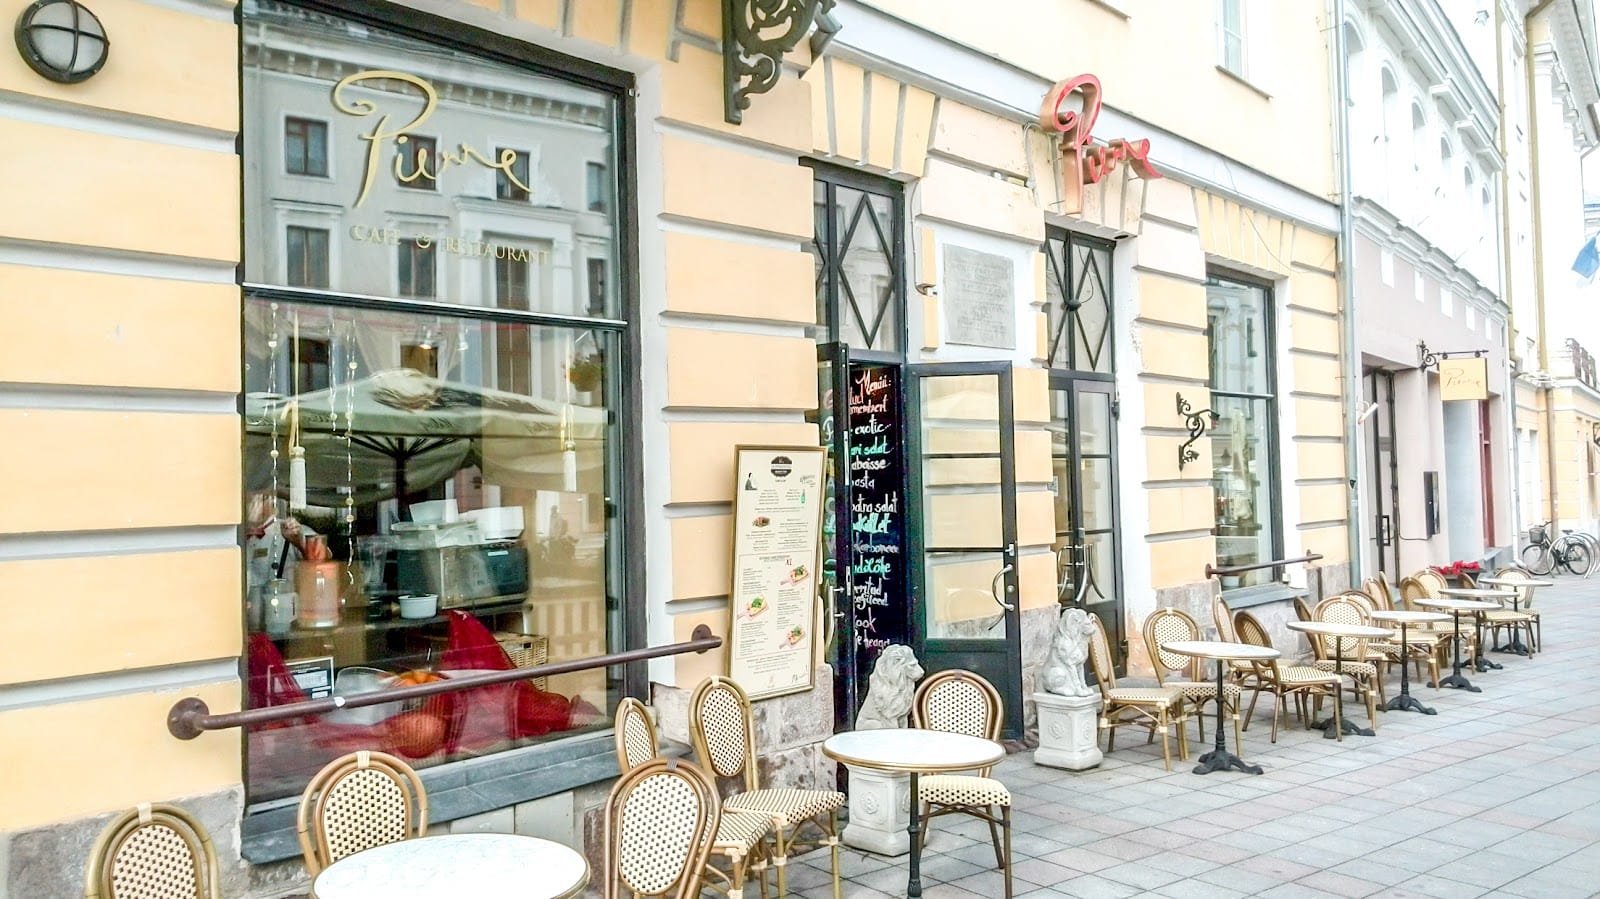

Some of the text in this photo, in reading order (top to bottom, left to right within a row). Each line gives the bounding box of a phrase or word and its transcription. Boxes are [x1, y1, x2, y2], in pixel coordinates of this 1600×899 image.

[331, 70, 534, 209] Pierre
[445, 236, 550, 265] RESTAURANT
[874, 490, 898, 514] salat
